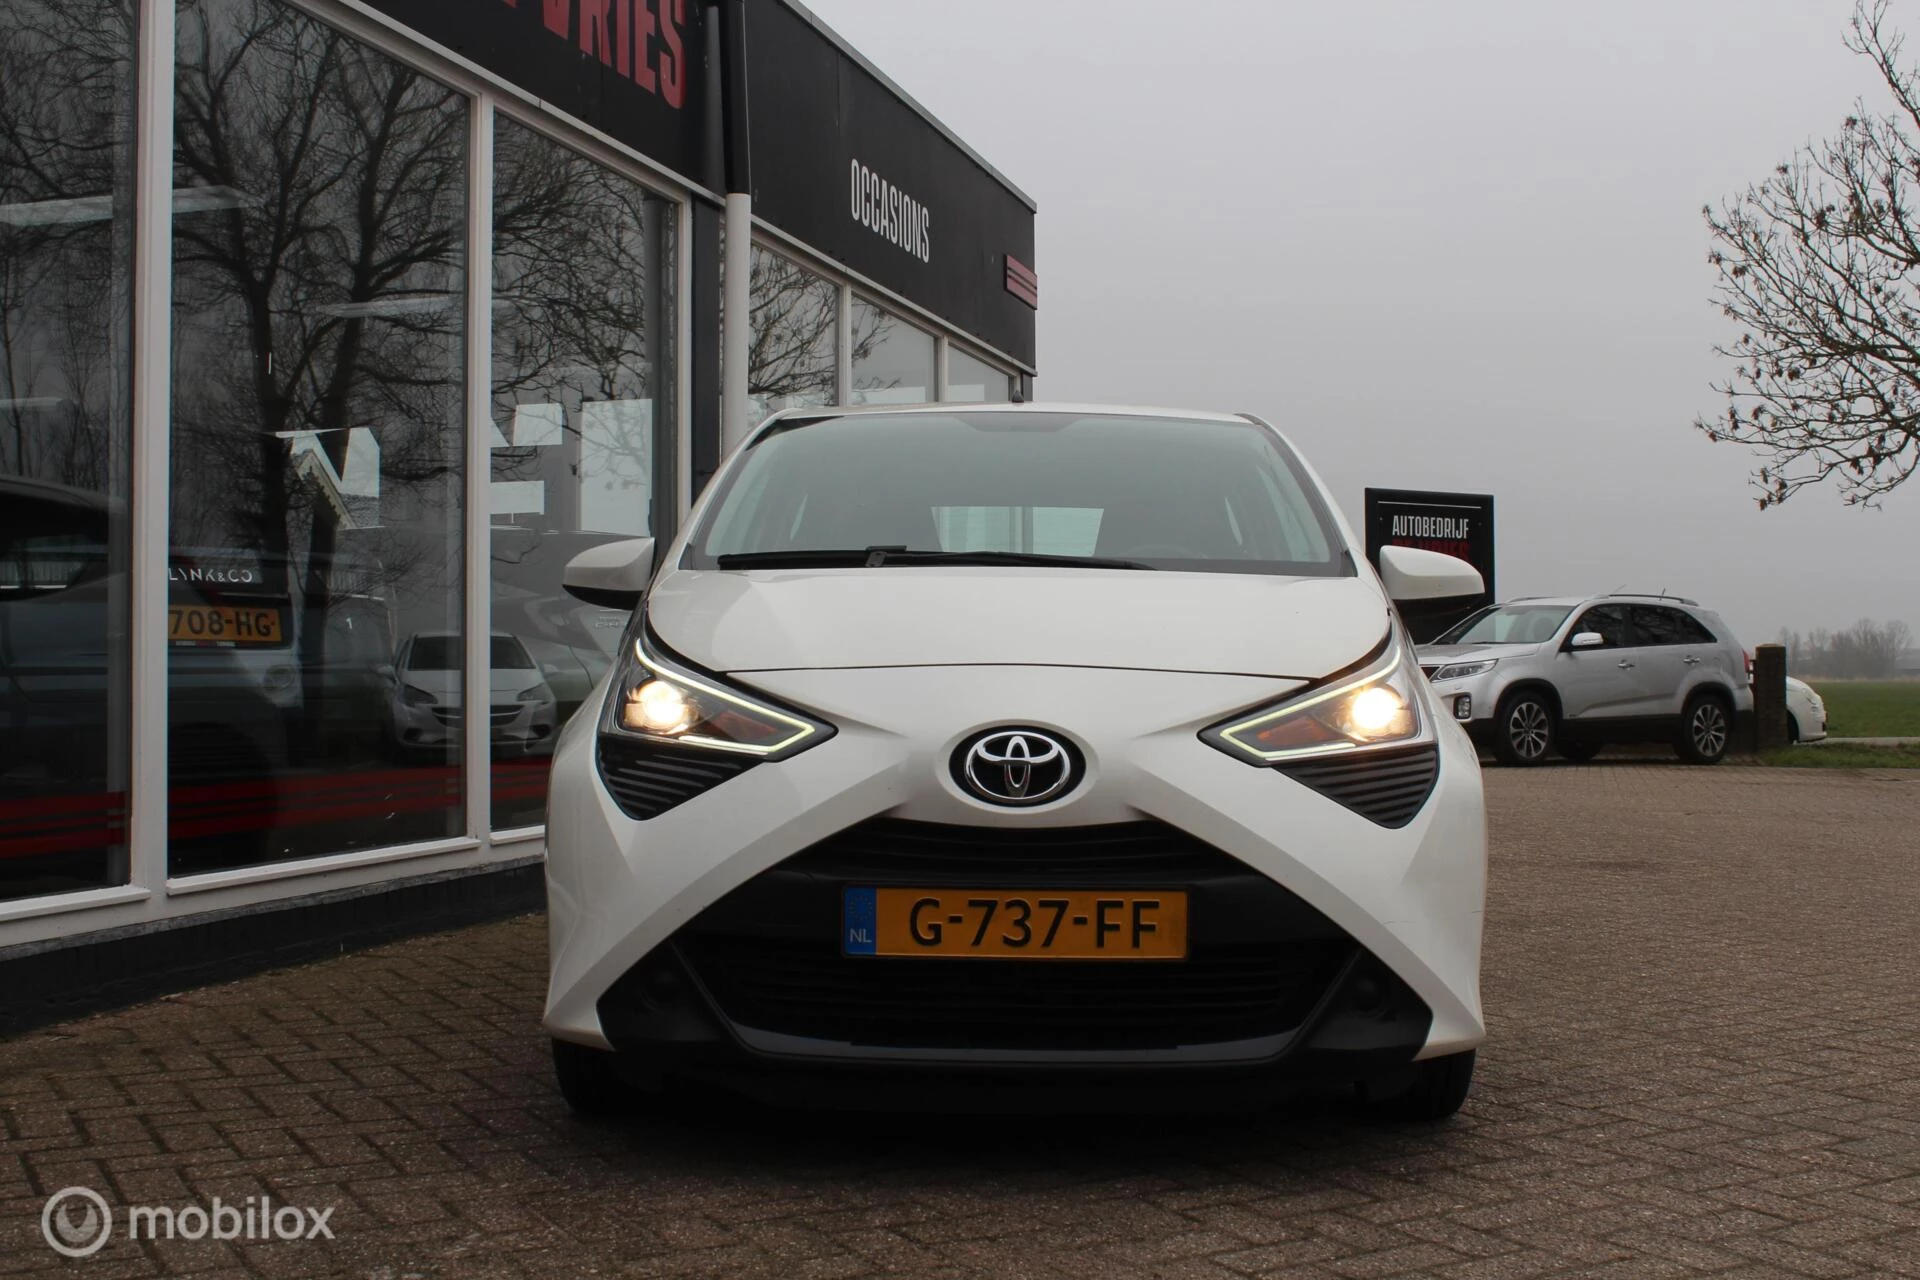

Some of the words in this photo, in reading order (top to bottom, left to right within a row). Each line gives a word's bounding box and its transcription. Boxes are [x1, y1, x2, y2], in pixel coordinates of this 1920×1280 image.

[543, 0, 687, 109] IES
[851, 158, 930, 263] OCCASIONS
[1392, 515, 1470, 539] AUTOBEDRIJF
[850, 929, 872, 943] NL
[909, 897, 1161, 949] G-737-FF
